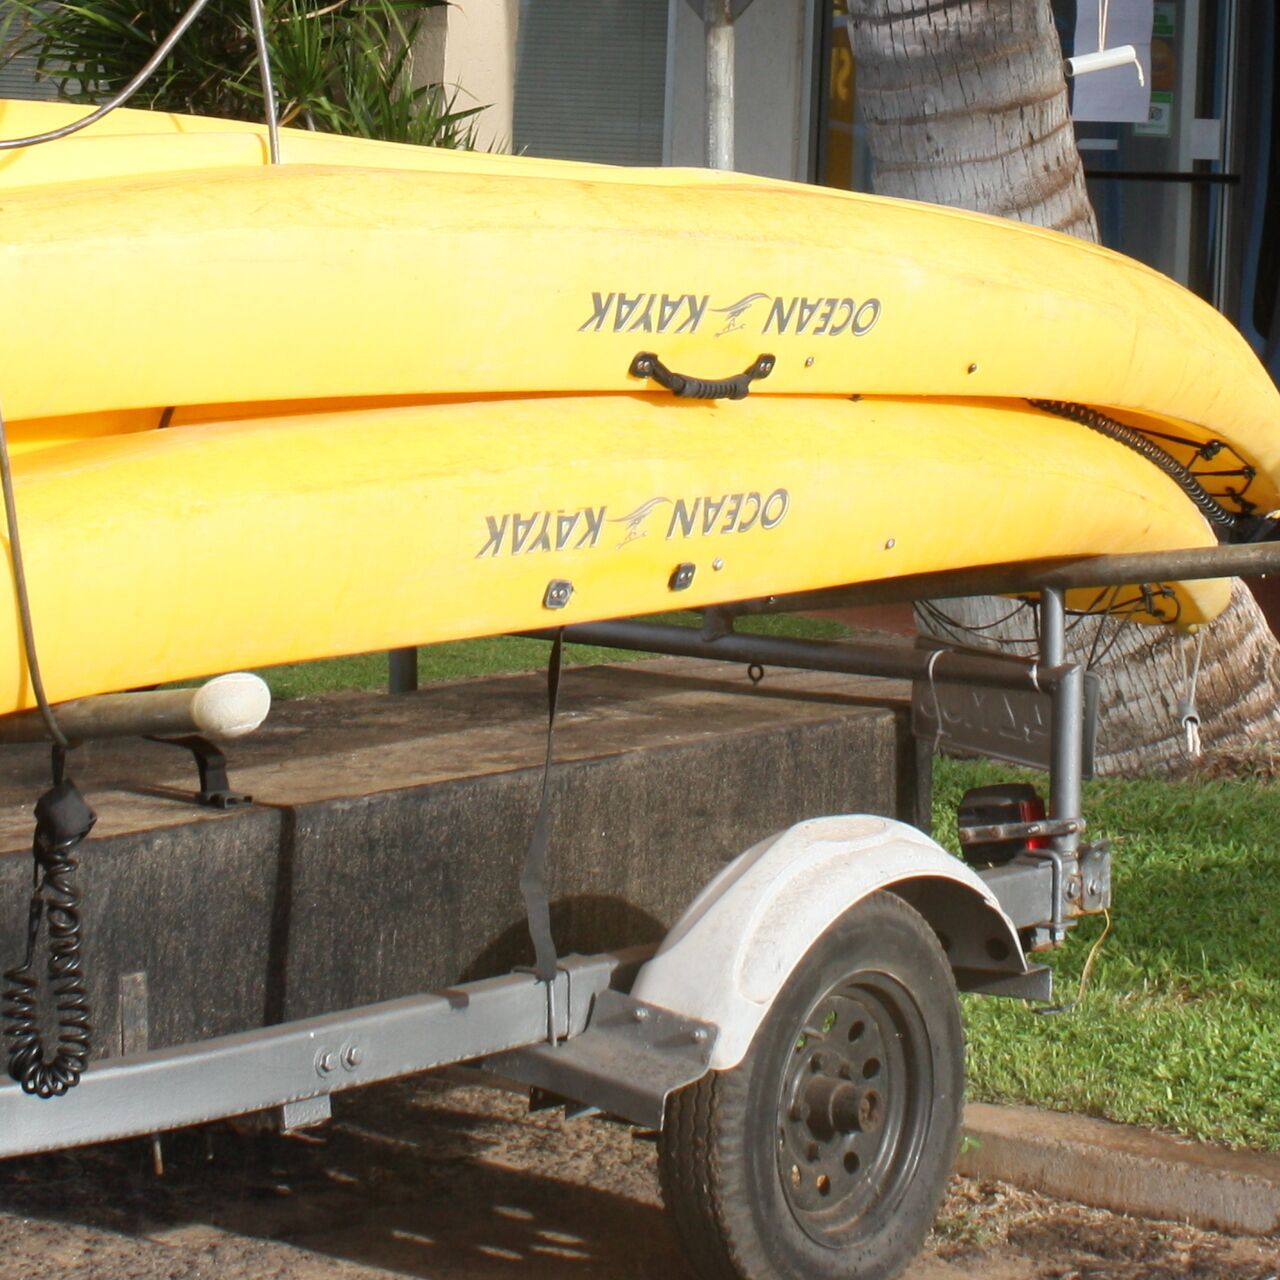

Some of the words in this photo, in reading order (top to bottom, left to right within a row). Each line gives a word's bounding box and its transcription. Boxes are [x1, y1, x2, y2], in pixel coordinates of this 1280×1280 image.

[577, 292, 710, 332] KAYAK
[762, 296, 881, 337] OCEAN
[475, 506, 607, 559] KAYAK
[666, 488, 790, 539] OCEAN
